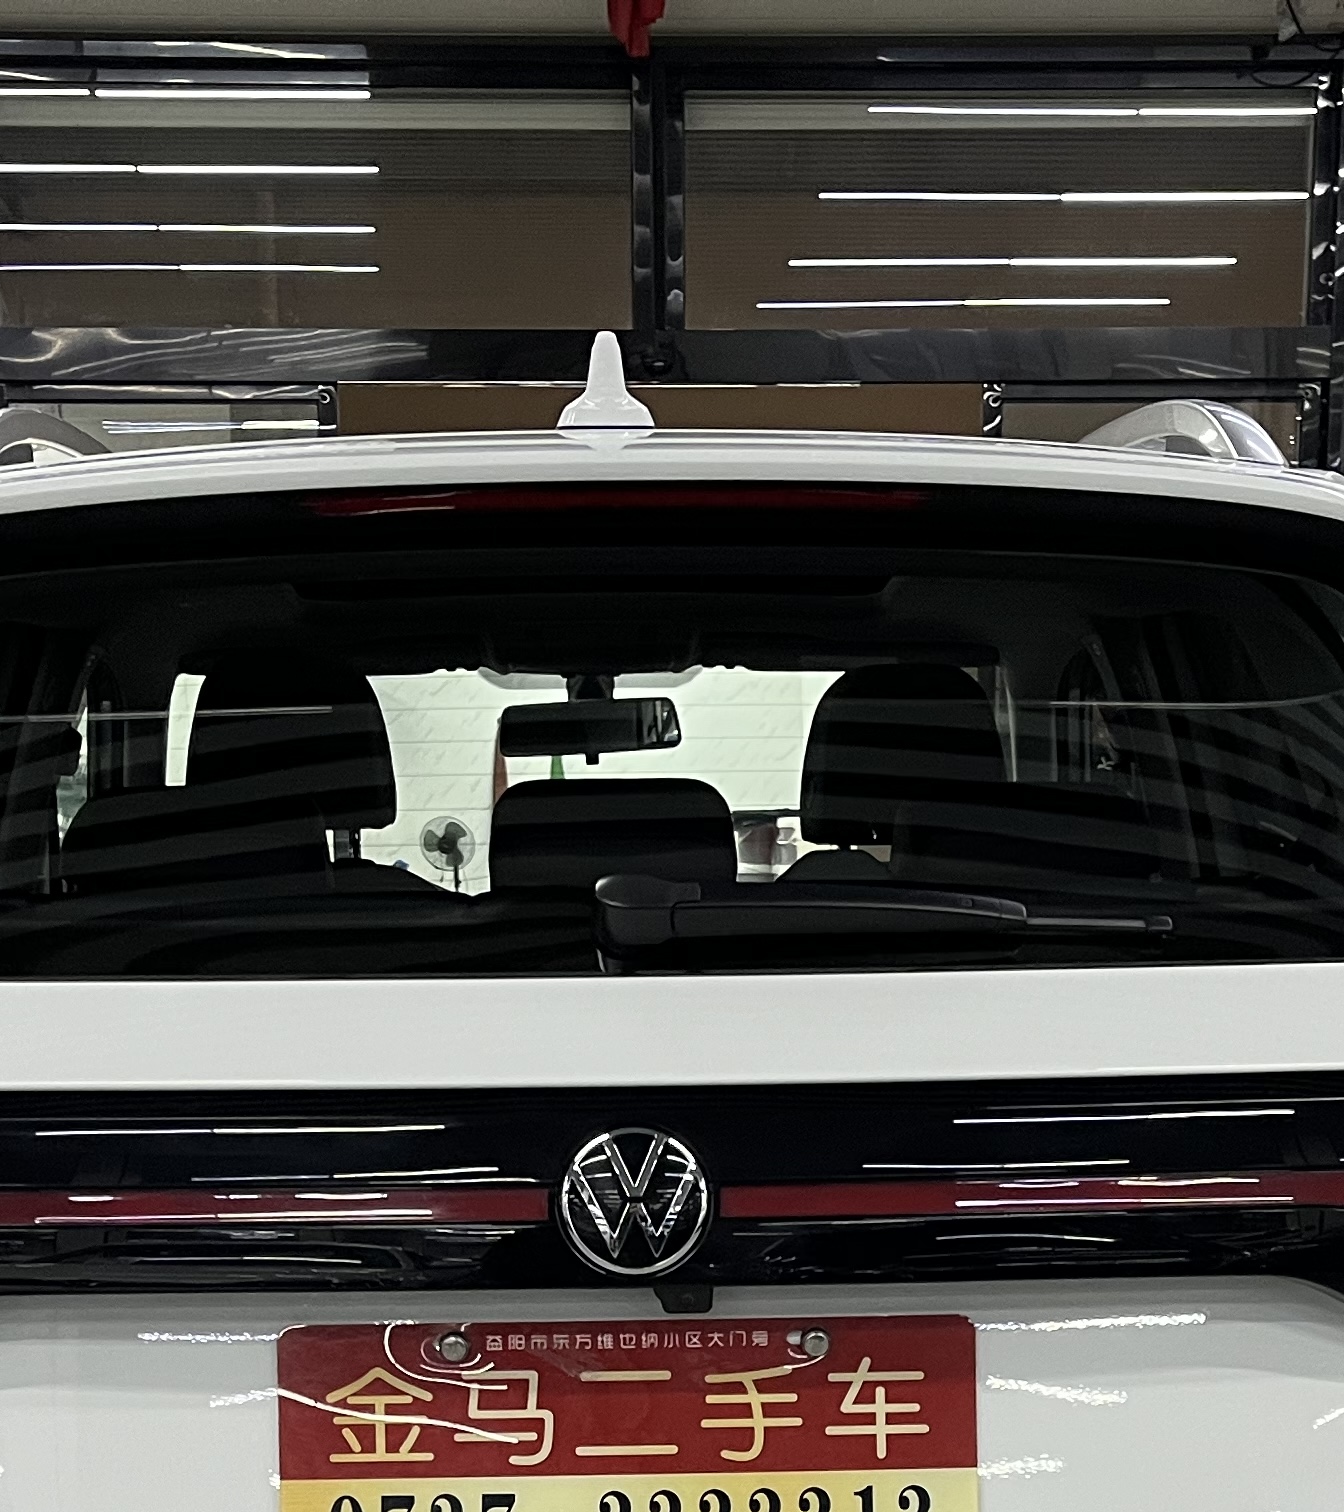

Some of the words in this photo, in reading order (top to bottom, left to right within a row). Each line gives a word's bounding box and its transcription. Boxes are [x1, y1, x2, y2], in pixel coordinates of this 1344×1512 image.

[325, 1356, 931, 1465] 金马二手车
